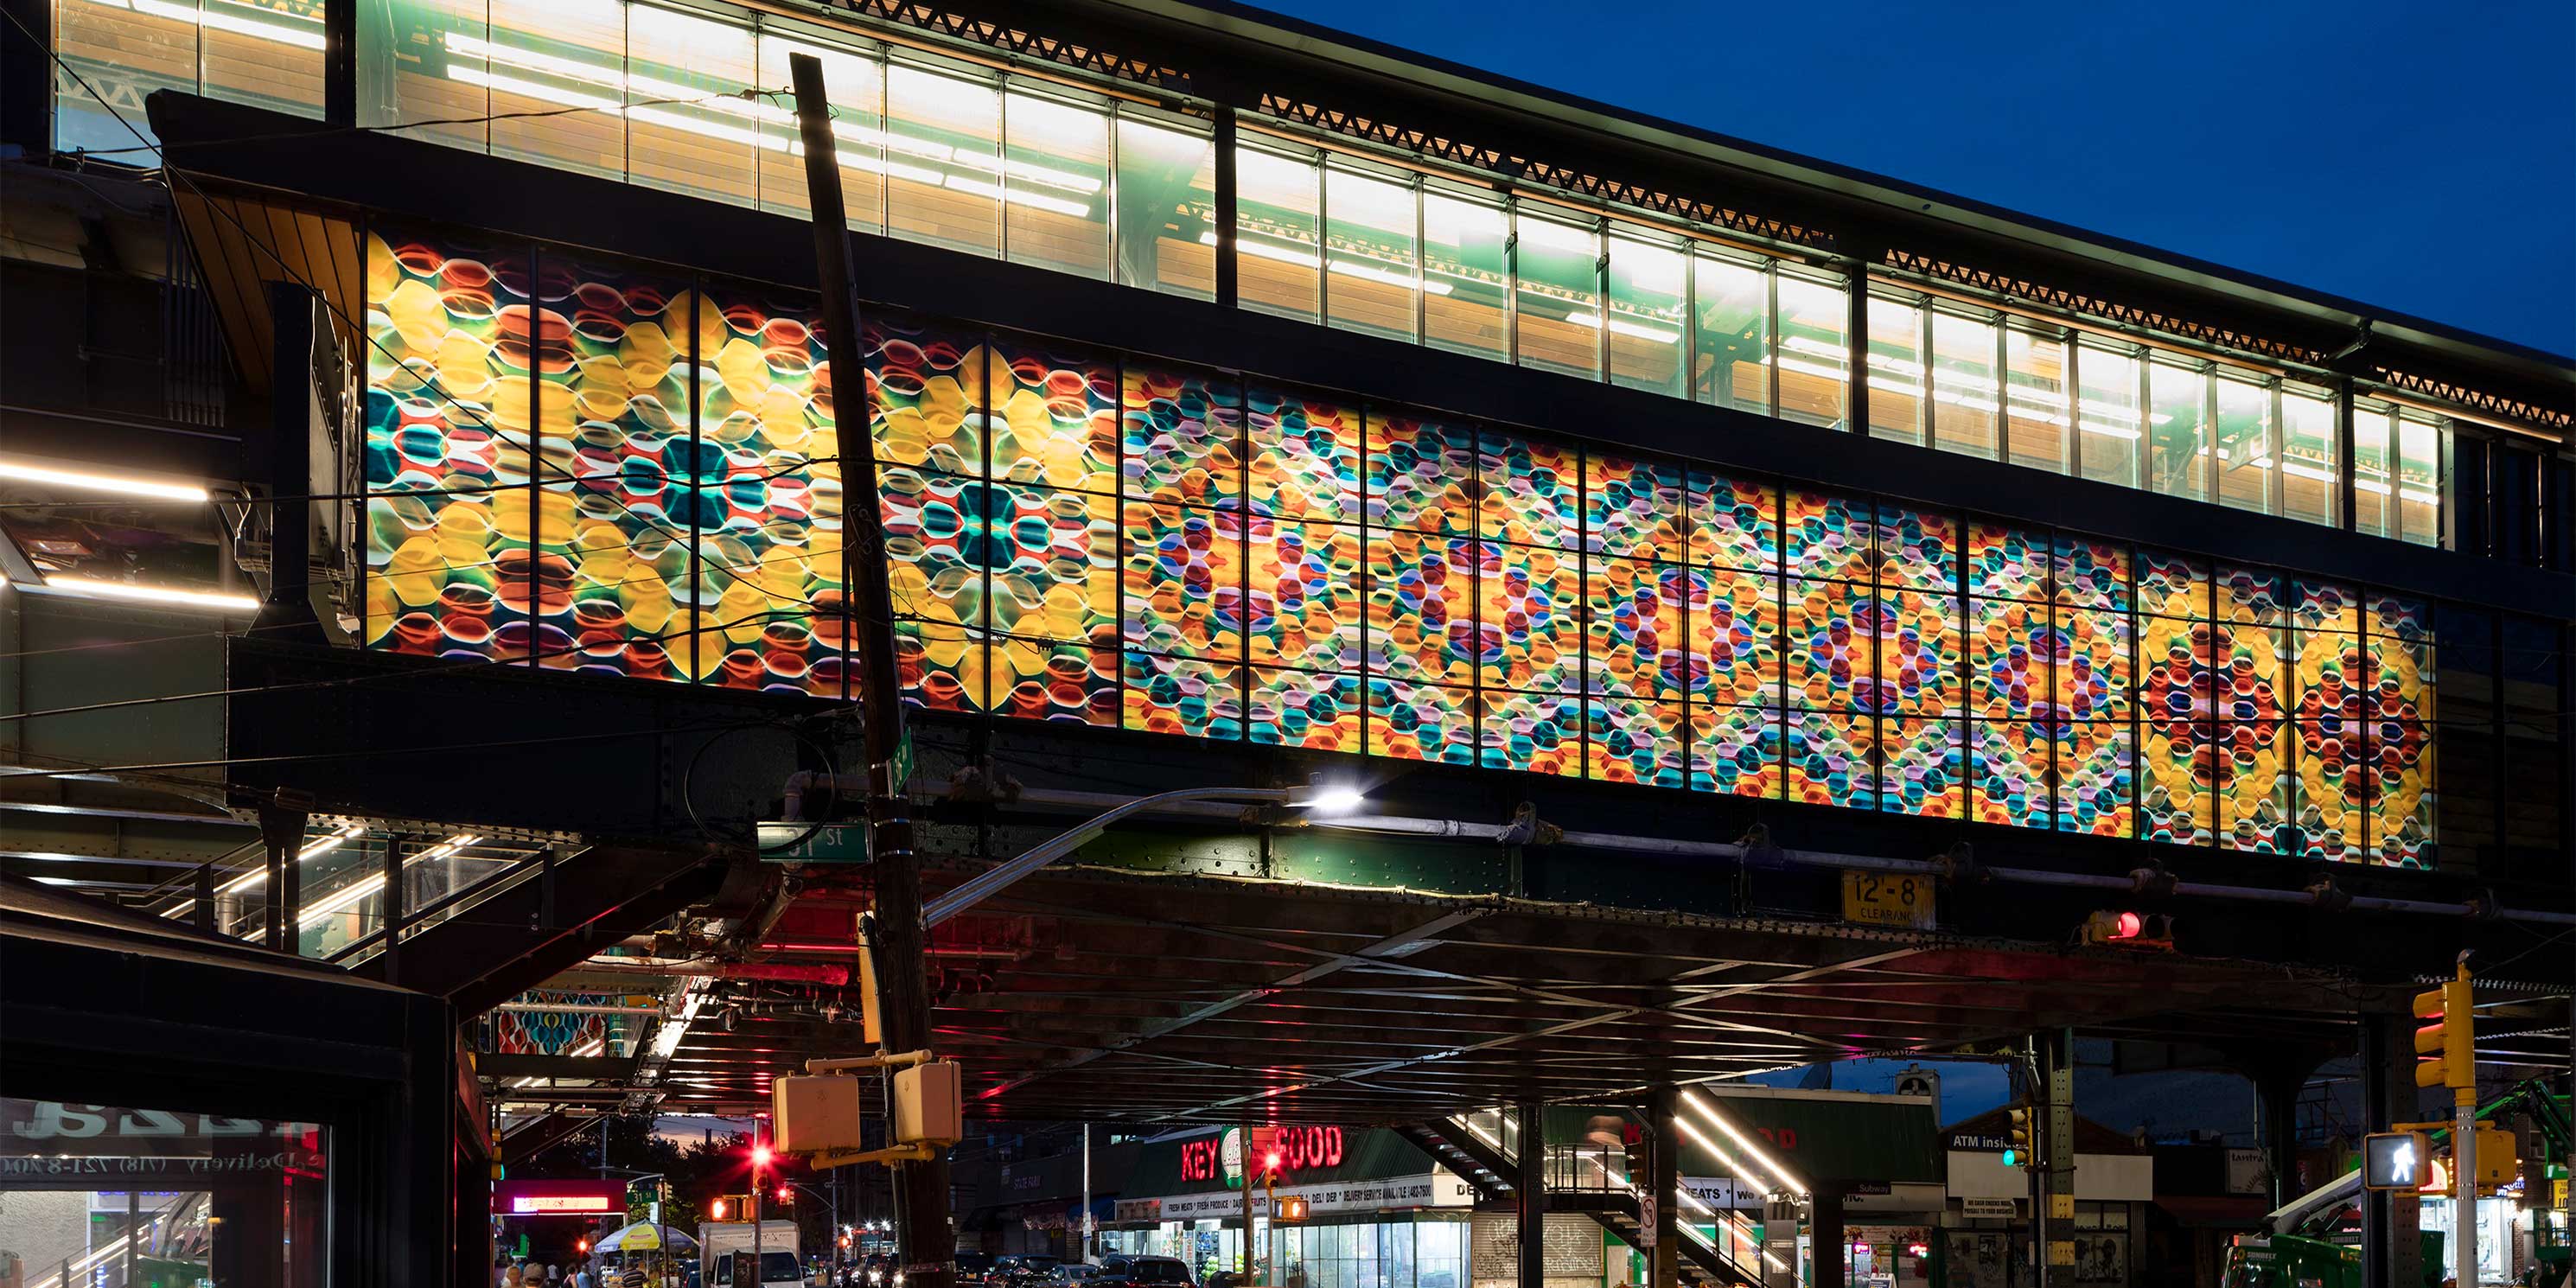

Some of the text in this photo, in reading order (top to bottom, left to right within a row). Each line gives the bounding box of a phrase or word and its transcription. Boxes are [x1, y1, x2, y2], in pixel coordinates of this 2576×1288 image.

[787, 828, 844, 858] 31 St
[1860, 908, 1912, 921] CLEARANC
[1953, 1135, 2017, 1149] ATM insi
[1181, 1138, 1219, 1183] KEY
[1274, 1125, 1343, 1170] FOOD
[1859, 1183, 1890, 1195] Subway
[634, 1193, 643, 1202] 31
